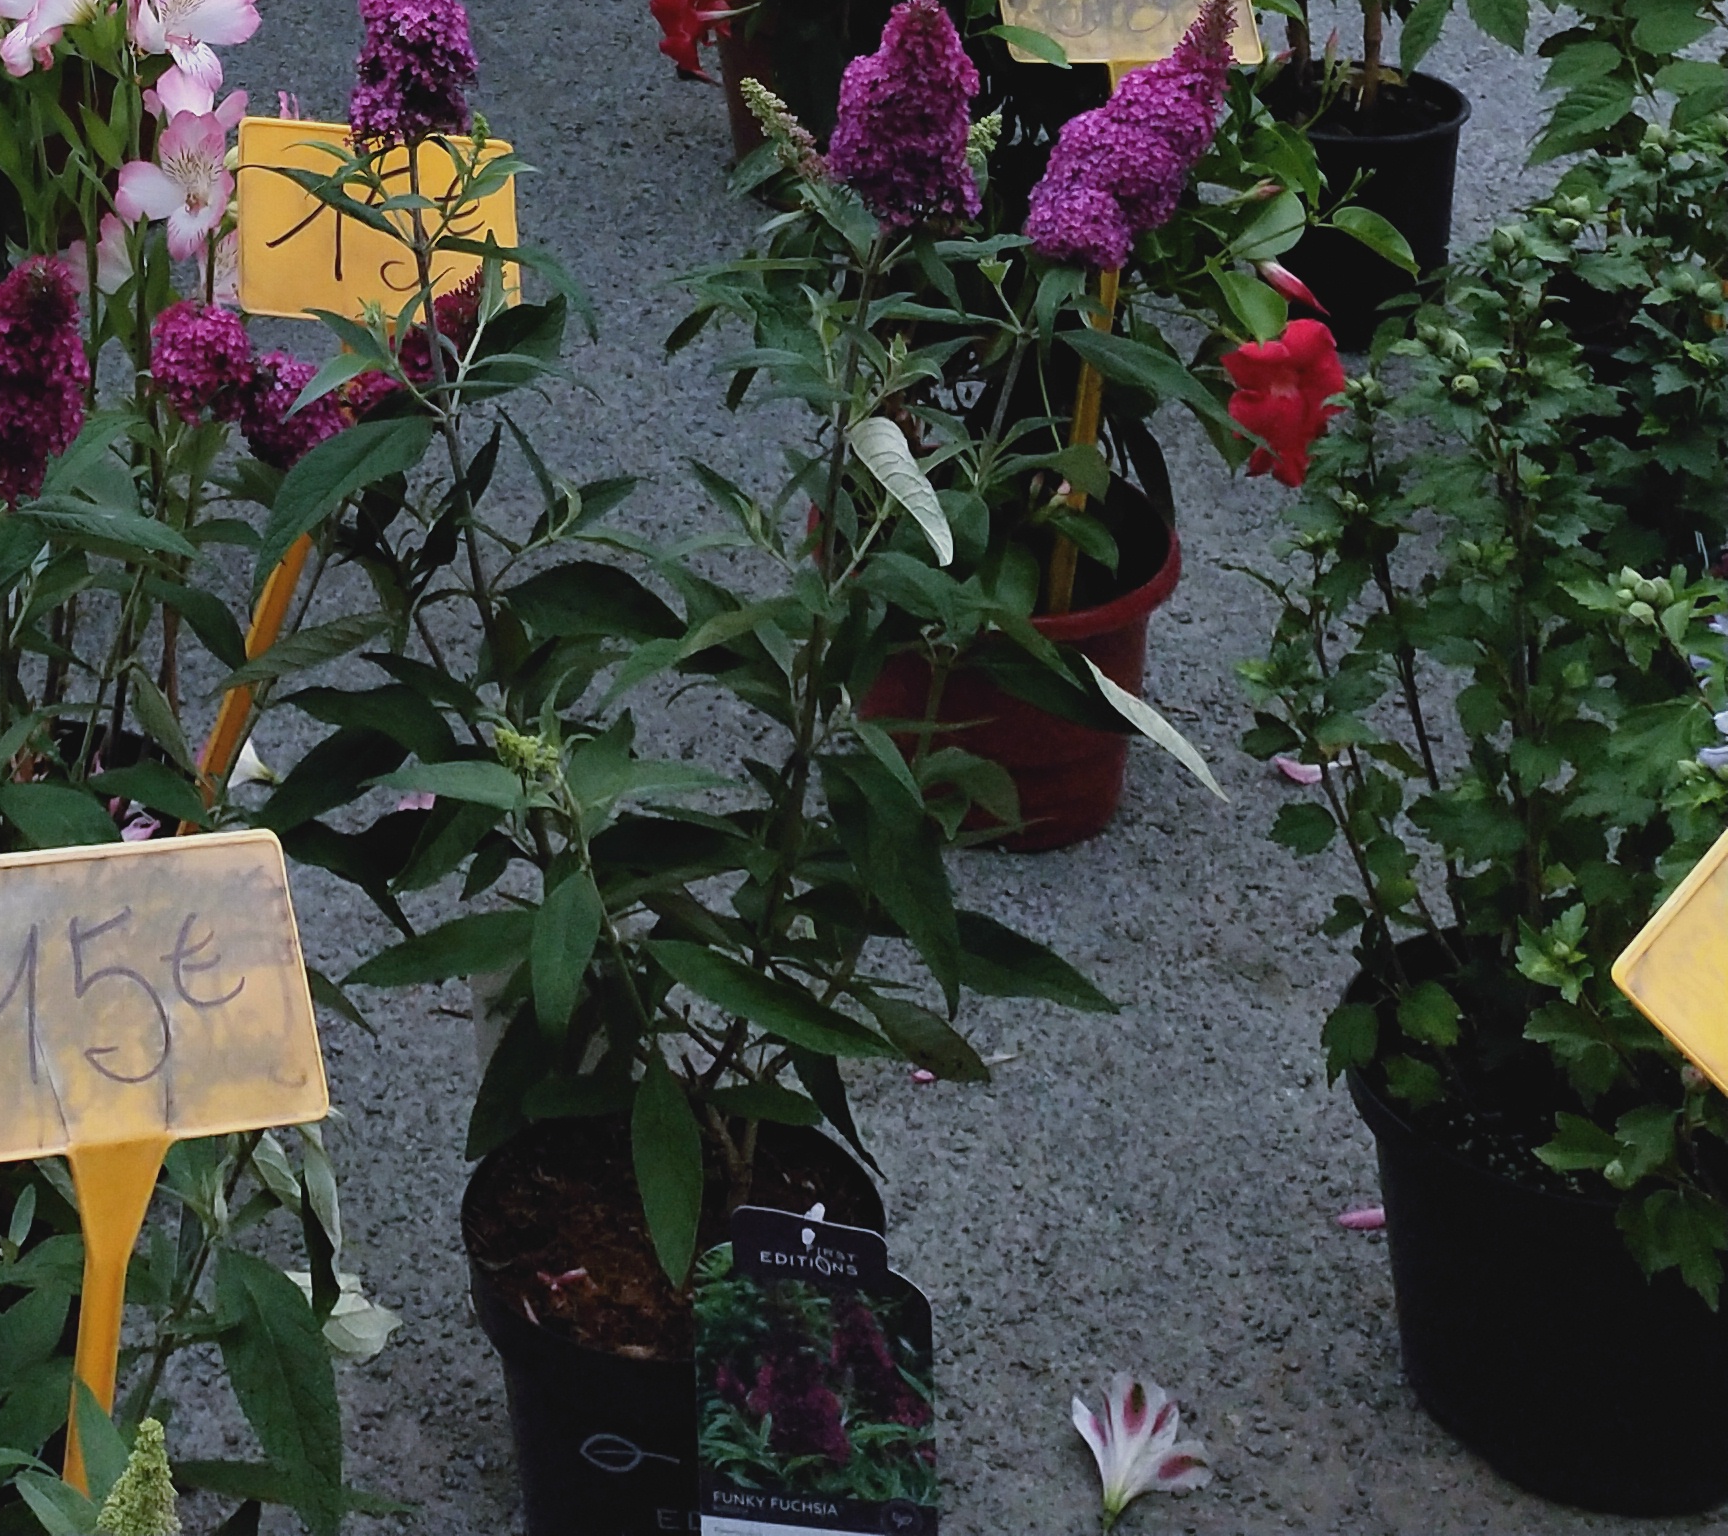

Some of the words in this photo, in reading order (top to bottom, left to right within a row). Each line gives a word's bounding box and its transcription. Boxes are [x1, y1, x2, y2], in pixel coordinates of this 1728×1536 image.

[760, 1250, 858, 1277] EDITIONS
[713, 1491, 766, 1508] FUNKY
[770, 1494, 839, 1516] FUCHSIA
